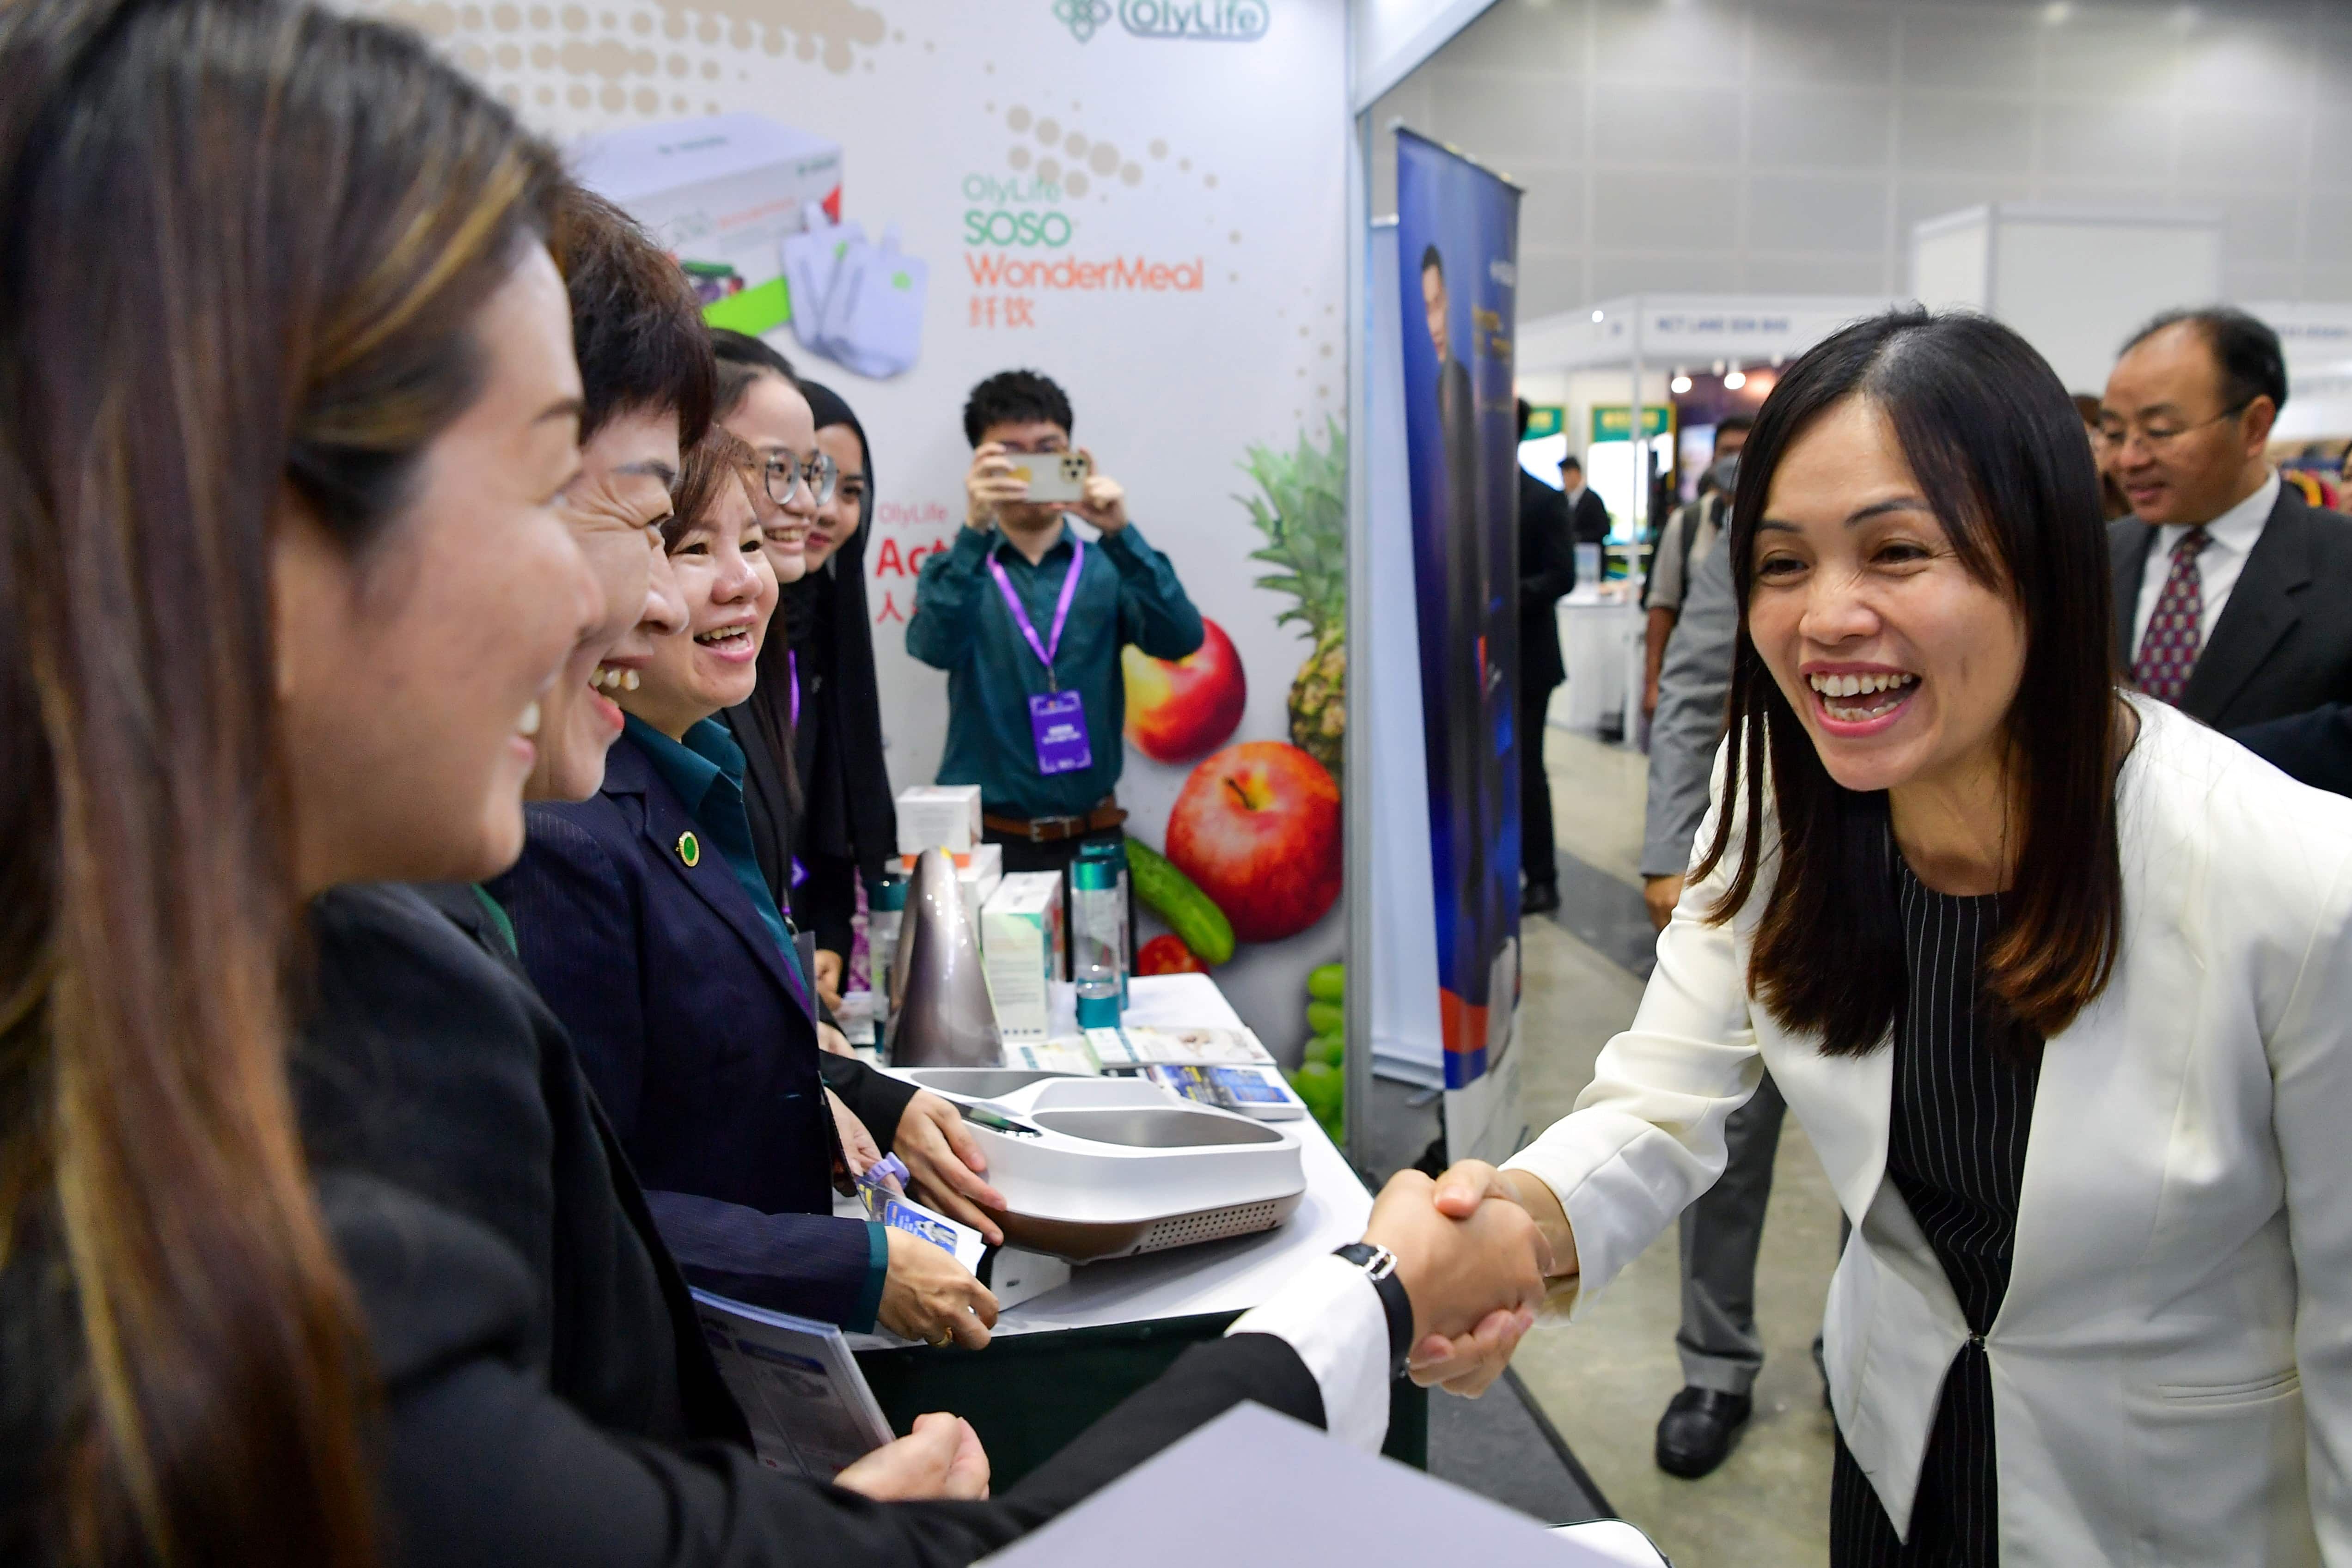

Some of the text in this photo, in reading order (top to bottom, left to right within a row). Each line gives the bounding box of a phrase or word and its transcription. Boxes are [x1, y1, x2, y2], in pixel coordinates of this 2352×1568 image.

[961, 173, 1062, 206] OlyLife
[964, 210, 1072, 247] SOSO
[965, 252, 1204, 292] WonderMeal
[878, 502, 950, 528] OlyLife
[876, 589, 918, 623] 人
